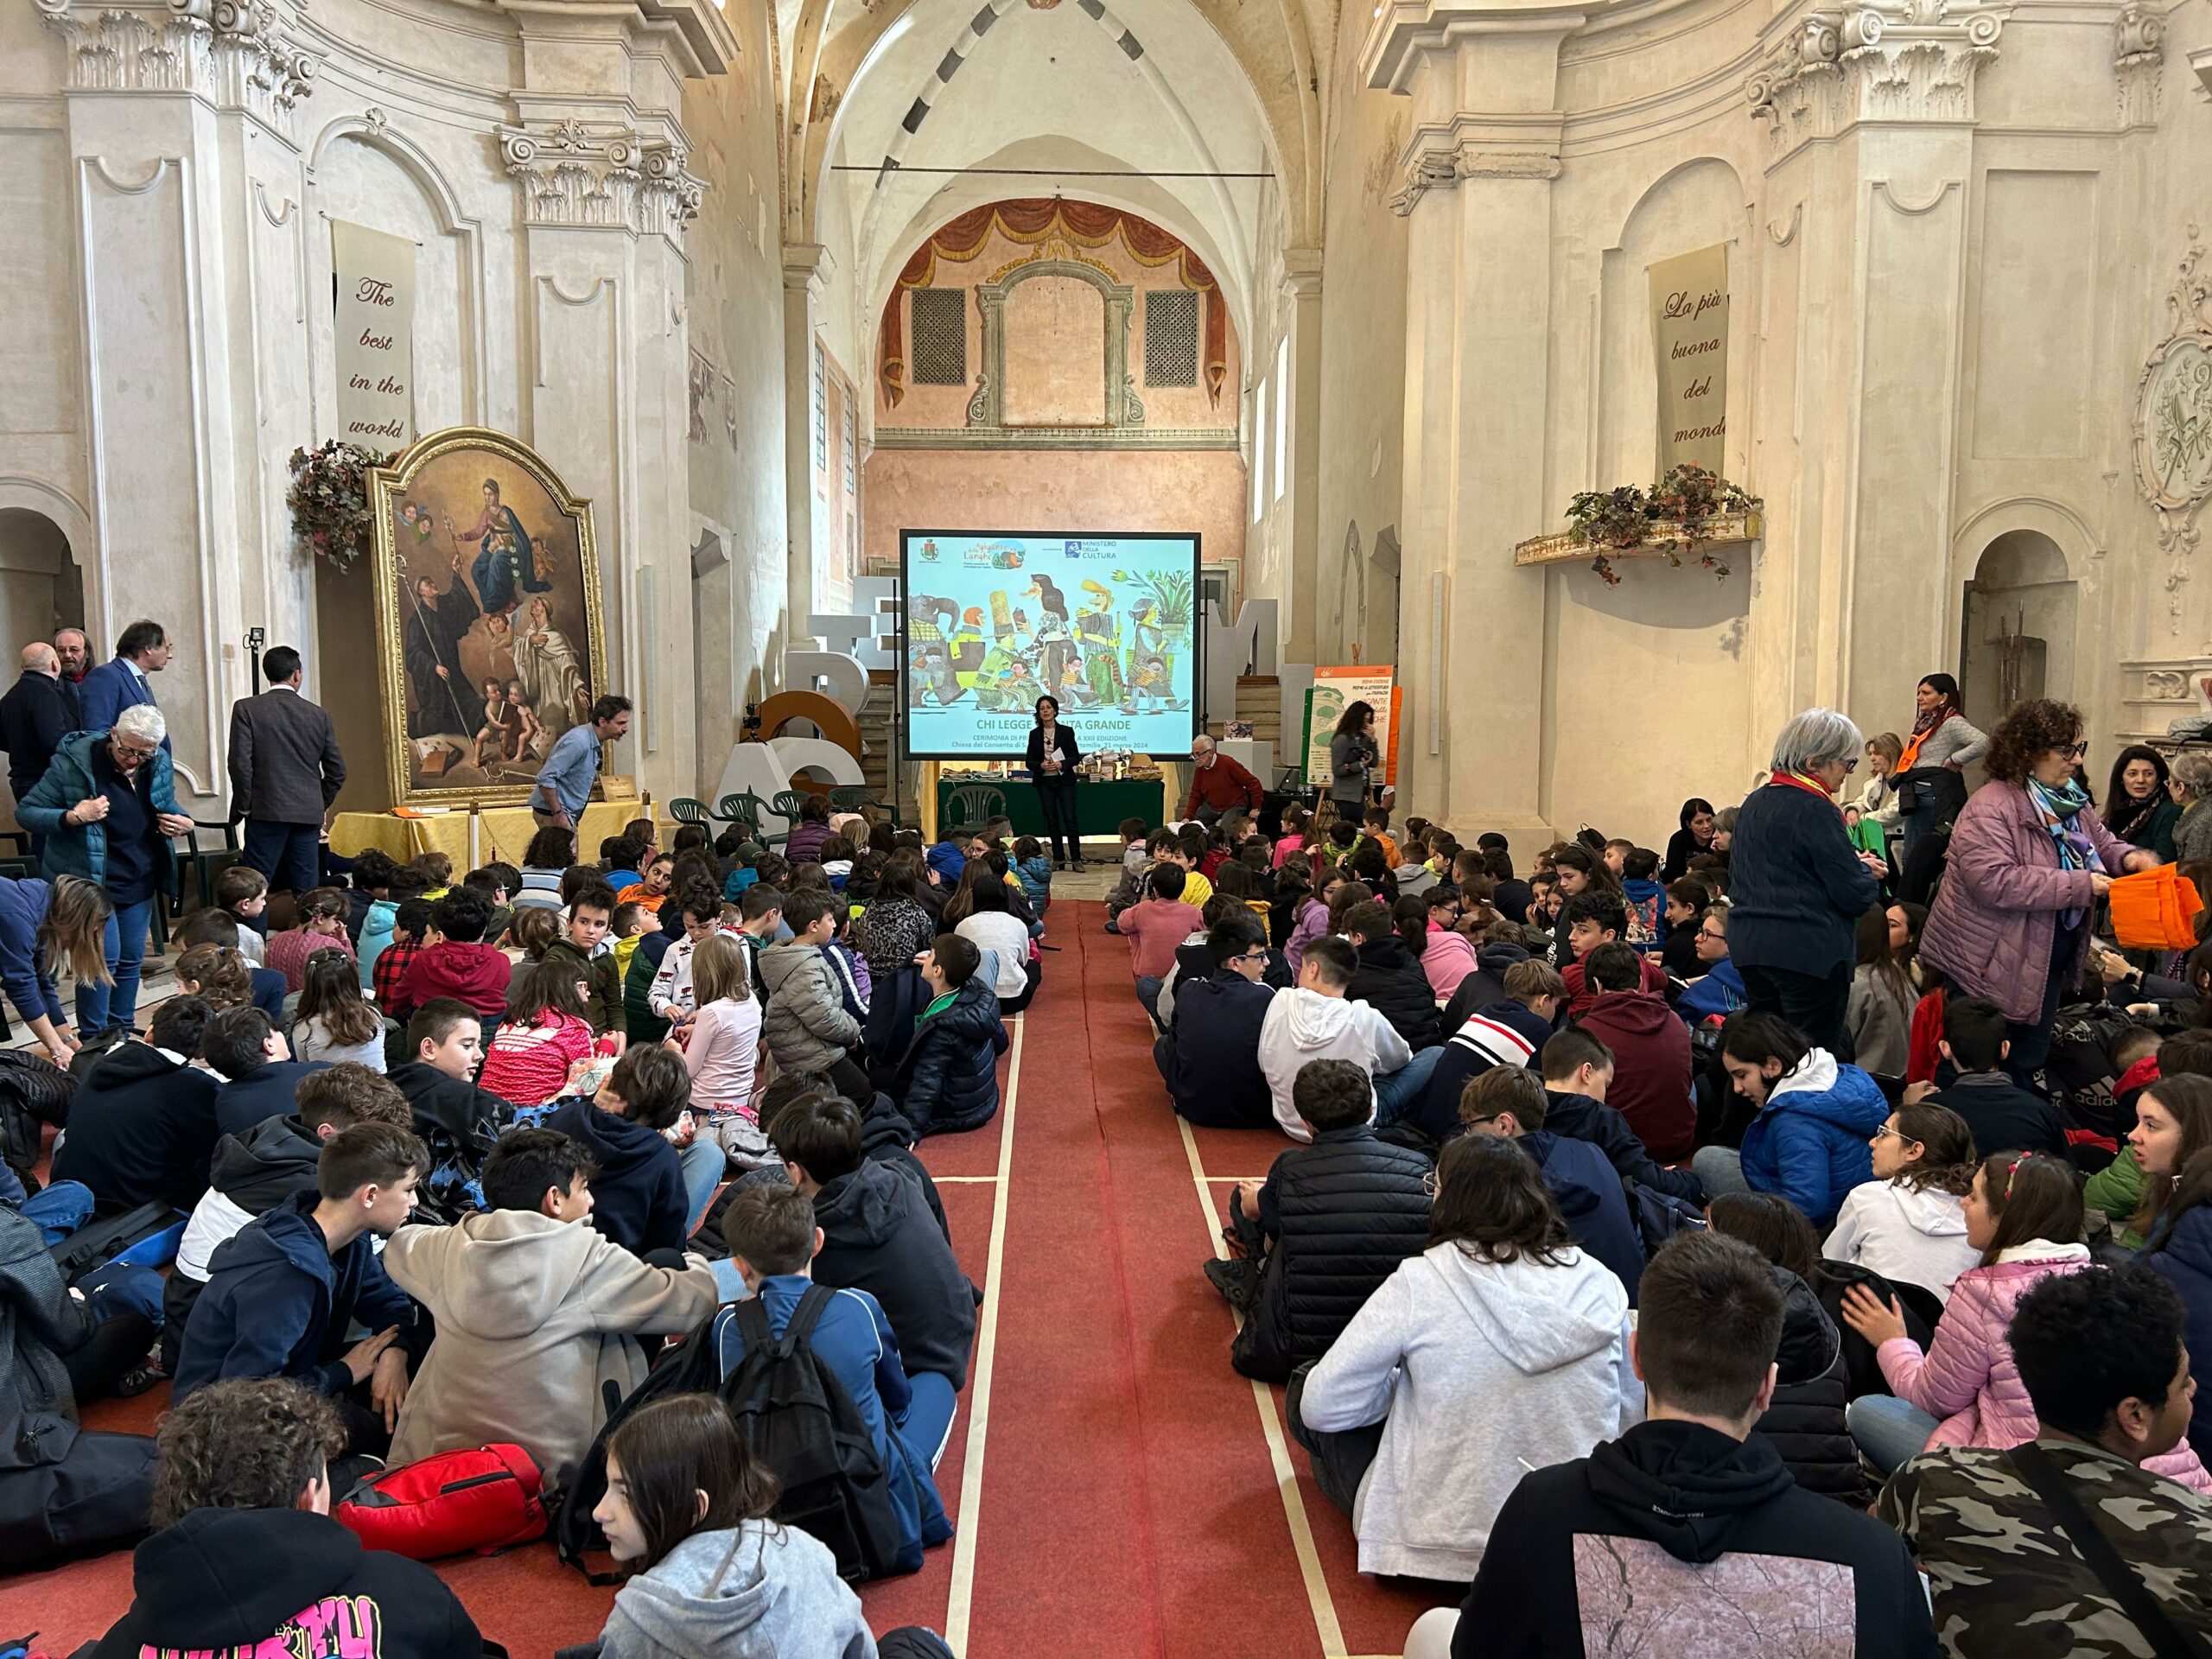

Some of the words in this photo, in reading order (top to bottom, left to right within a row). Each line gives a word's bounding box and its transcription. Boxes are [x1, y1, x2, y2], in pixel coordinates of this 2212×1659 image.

[355, 276, 395, 308] The
[1662, 290, 1694, 321] La
[1693, 289, 1722, 321] più
[359, 327, 393, 351] best
[1670, 338, 1721, 360] buona
[349, 373, 372, 391] in
[377, 375, 404, 396] the
[1682, 375, 1713, 400] del
[348, 418, 404, 439] world
[1673, 416, 1726, 443] mond
[963, 550, 992, 562] Langhe
[980, 543, 1008, 553] gigante
[976, 720, 995, 729] CHI
[999, 720, 1033, 730] LEGGE
[1085, 721, 1131, 730] GRANDE
